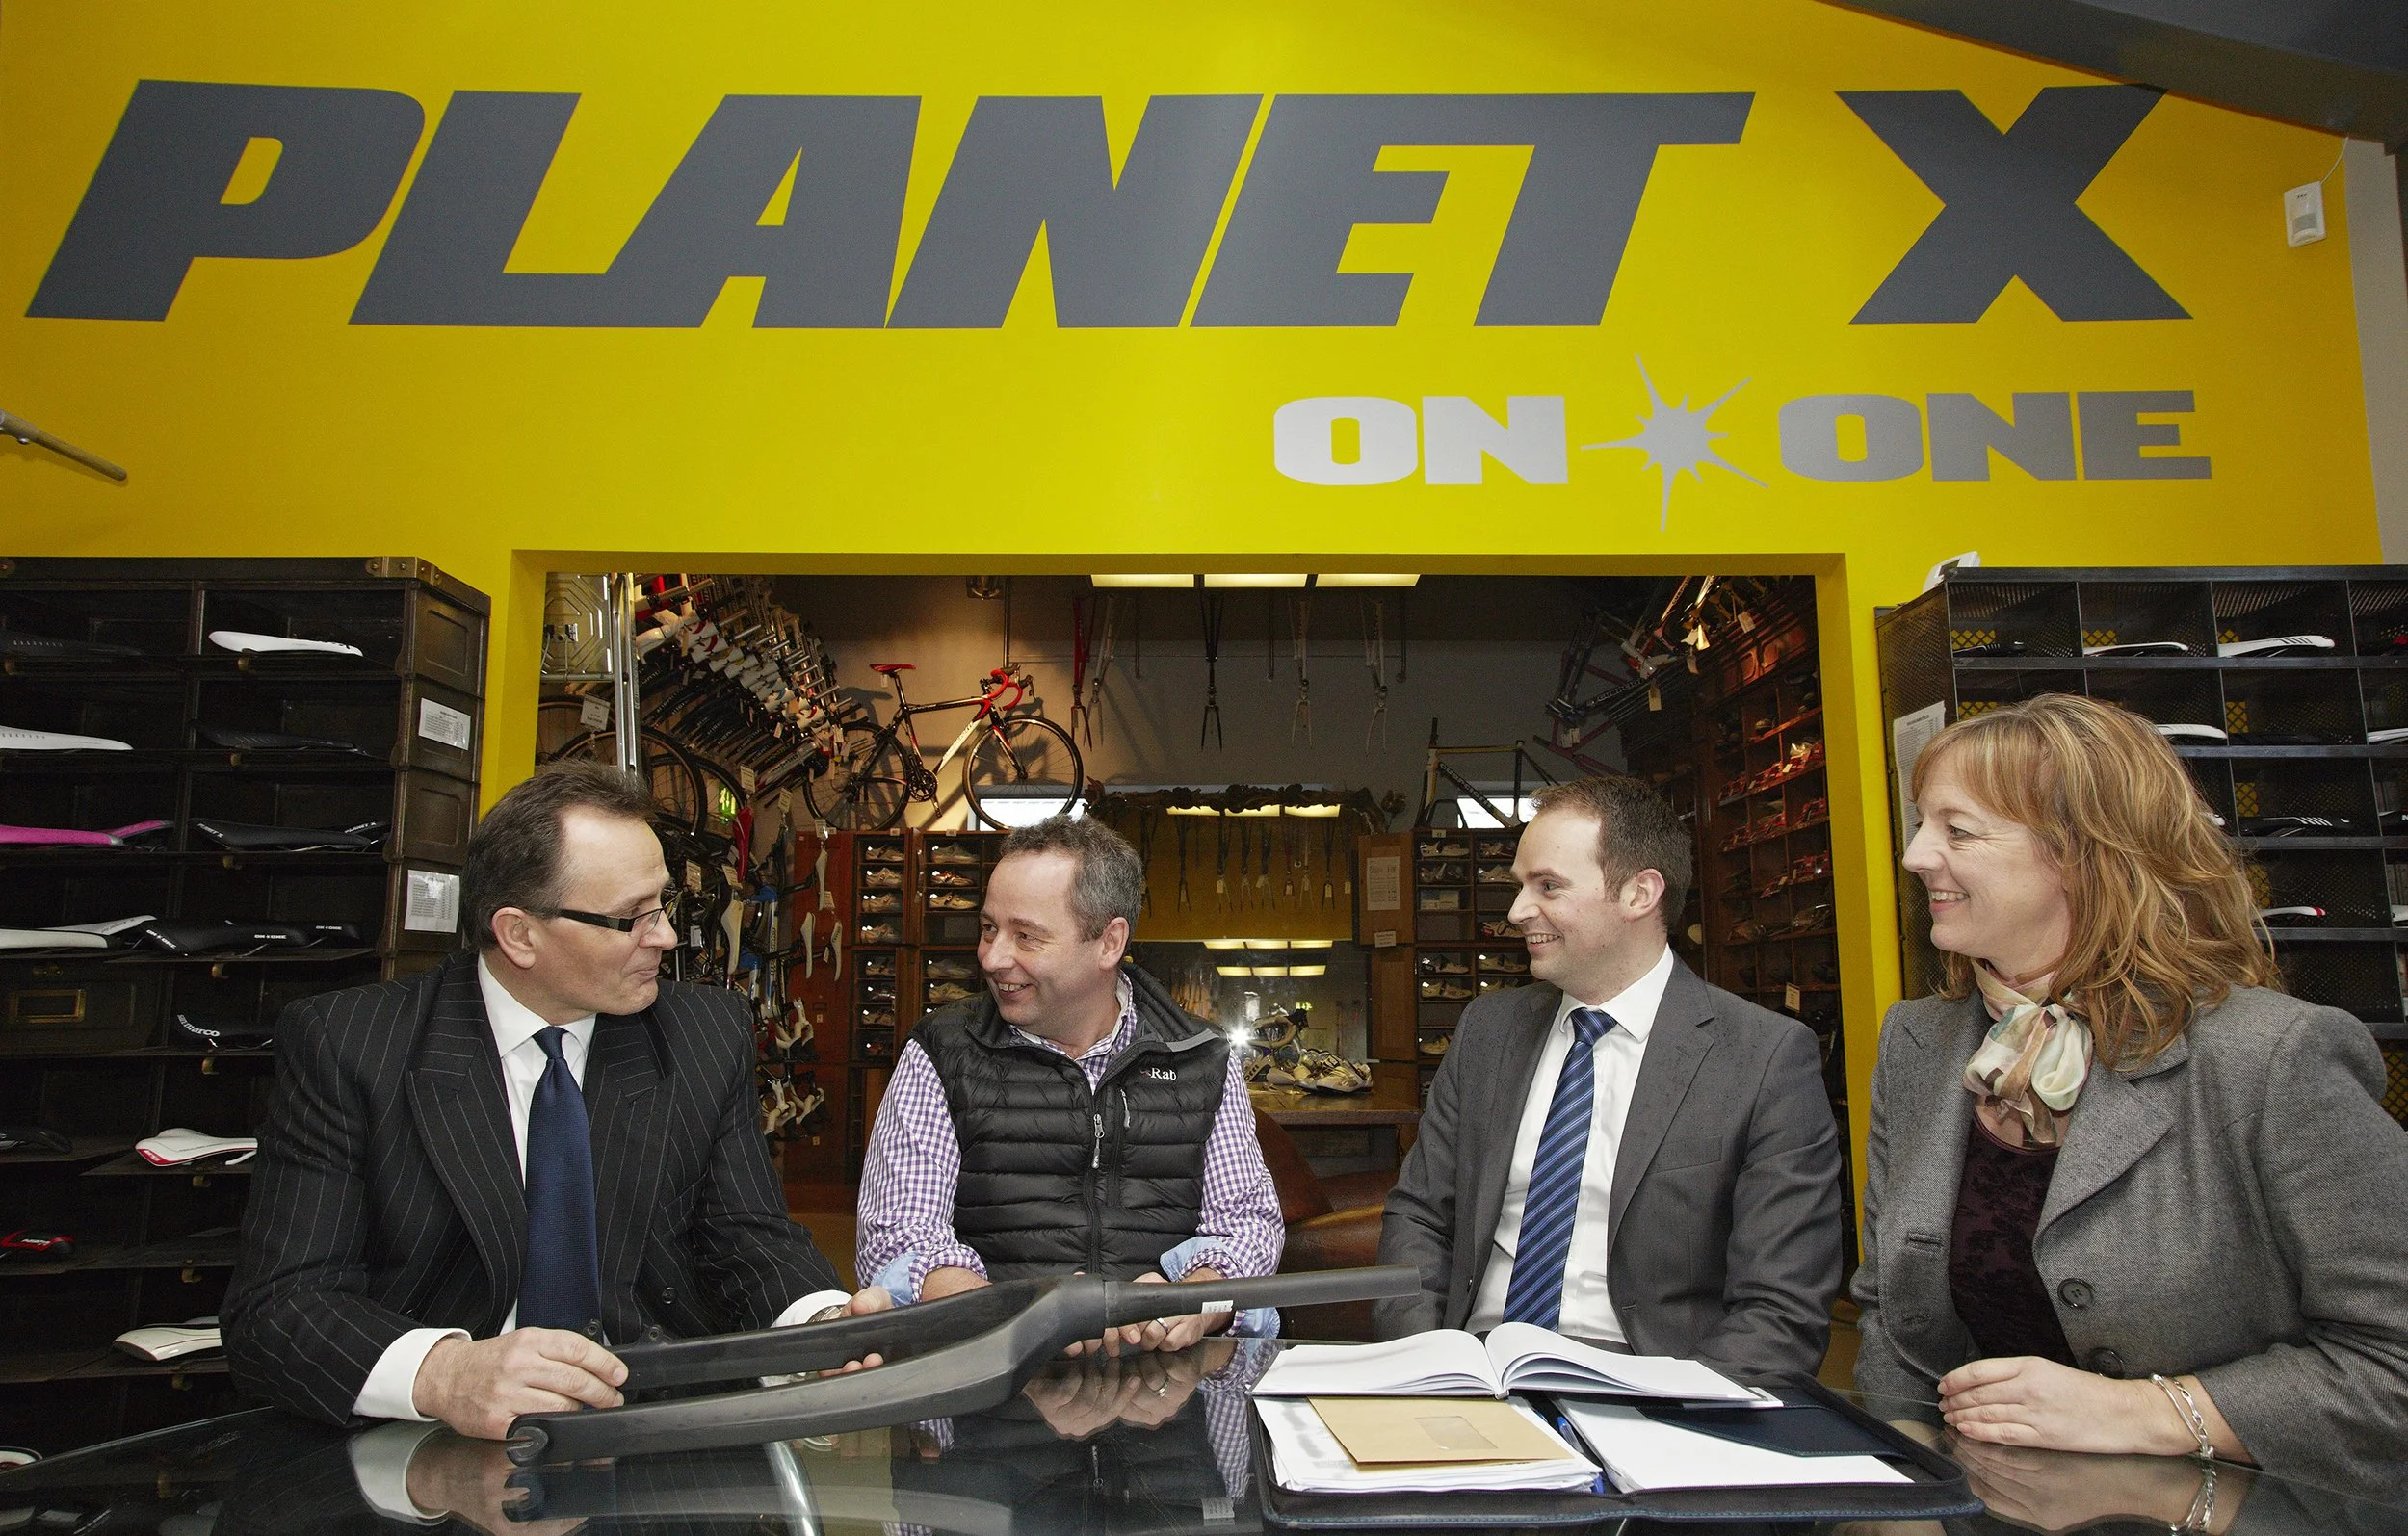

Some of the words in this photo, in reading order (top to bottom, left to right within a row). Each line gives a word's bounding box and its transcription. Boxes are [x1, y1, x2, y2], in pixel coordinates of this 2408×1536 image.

[27, 81, 1754, 328] PLANET
[1835, 83, 2193, 325] X
[1273, 395, 1569, 486] ON
[1778, 391, 2212, 482] ONE
[1151, 1067, 1177, 1080] Rab
